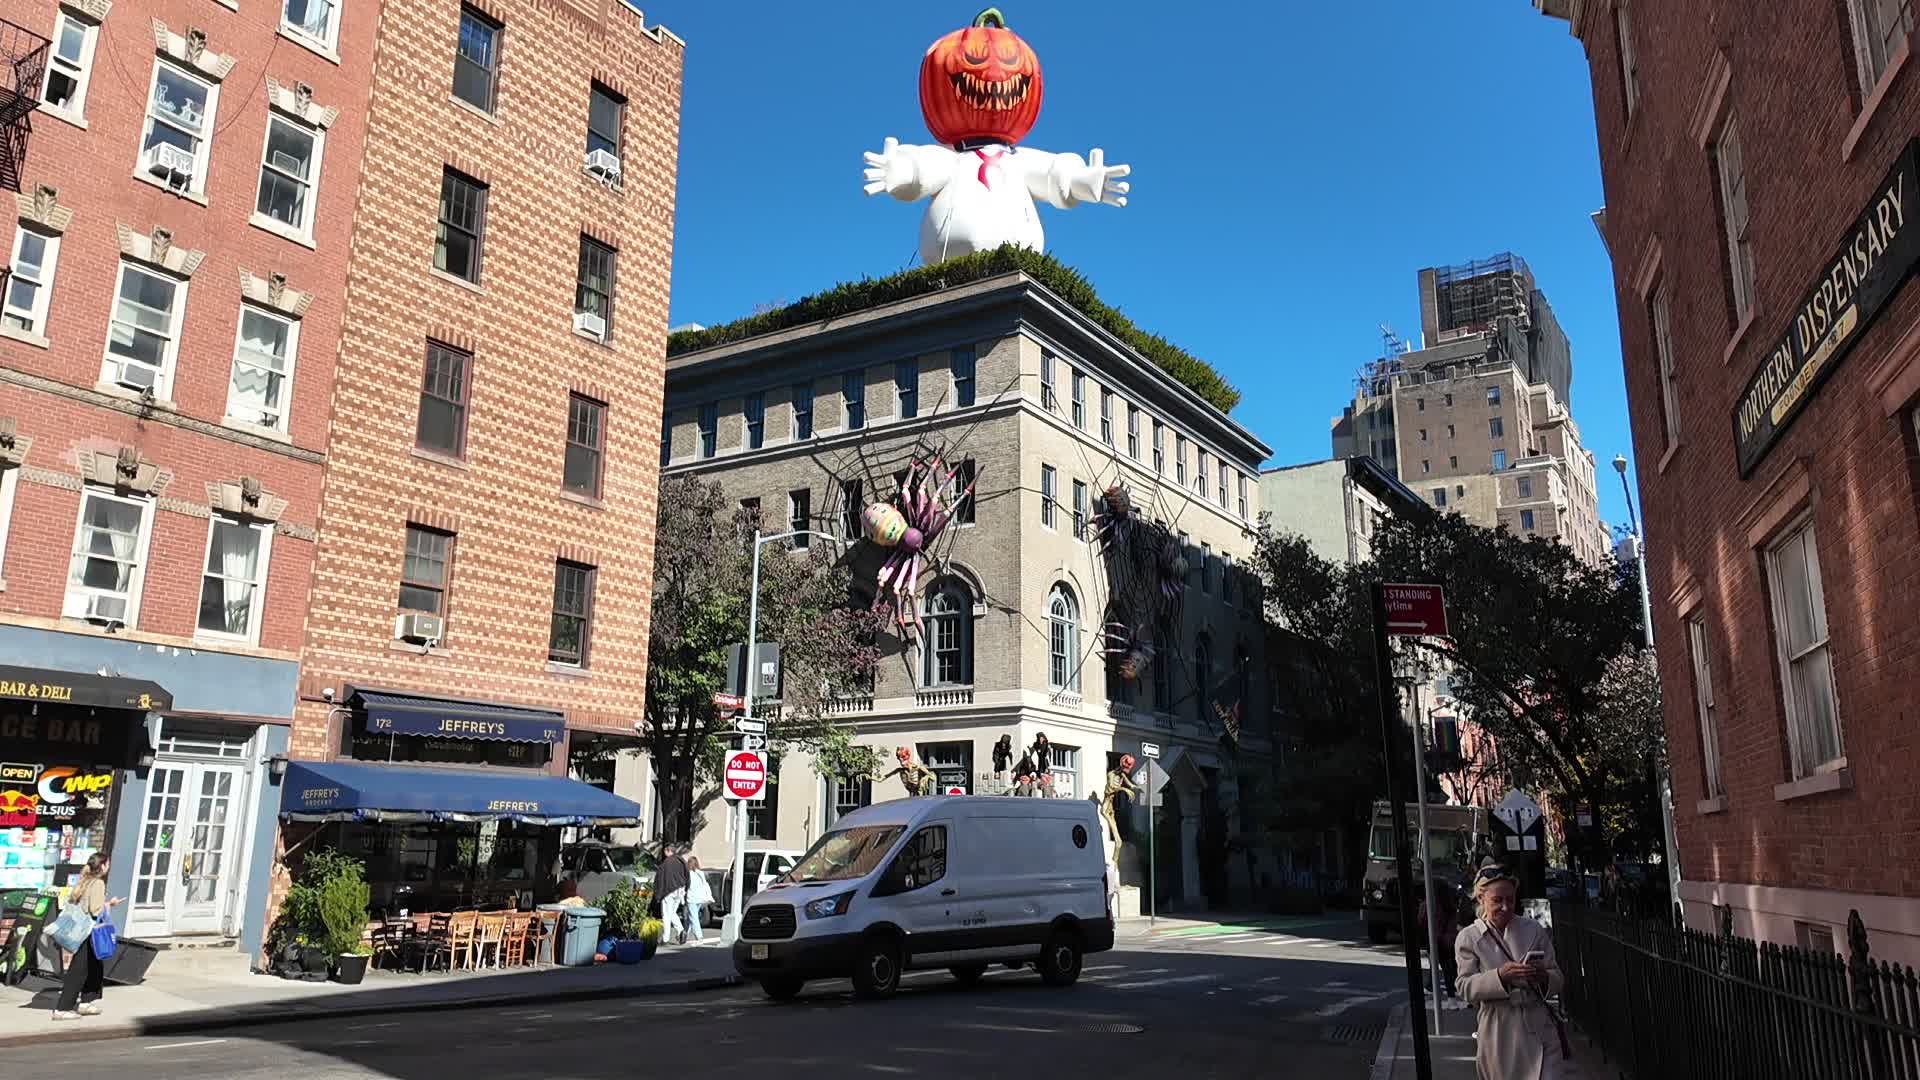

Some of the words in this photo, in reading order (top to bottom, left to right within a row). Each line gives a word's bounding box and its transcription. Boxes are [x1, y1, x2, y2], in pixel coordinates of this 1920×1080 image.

[1738, 336, 1795, 443] NORTHERN
[1796, 172, 1904, 354] DISPENSARY
[1389, 589, 1432, 600] STANDING
[0, 681, 26, 696] BAR
[27, 684, 39, 698] &
[40, 685, 72, 700] DELI
[375, 718, 392, 729] 172
[438, 719, 505, 735] JEFFREY'S
[731, 760, 743, 769] DO
[745, 761, 761, 770] NOT
[2, 767, 33, 779] OPEN
[732, 780, 756, 790] ENTER
[301, 787, 340, 800] JEFFREY'S
[487, 800, 538, 811] JEFFREY'S
